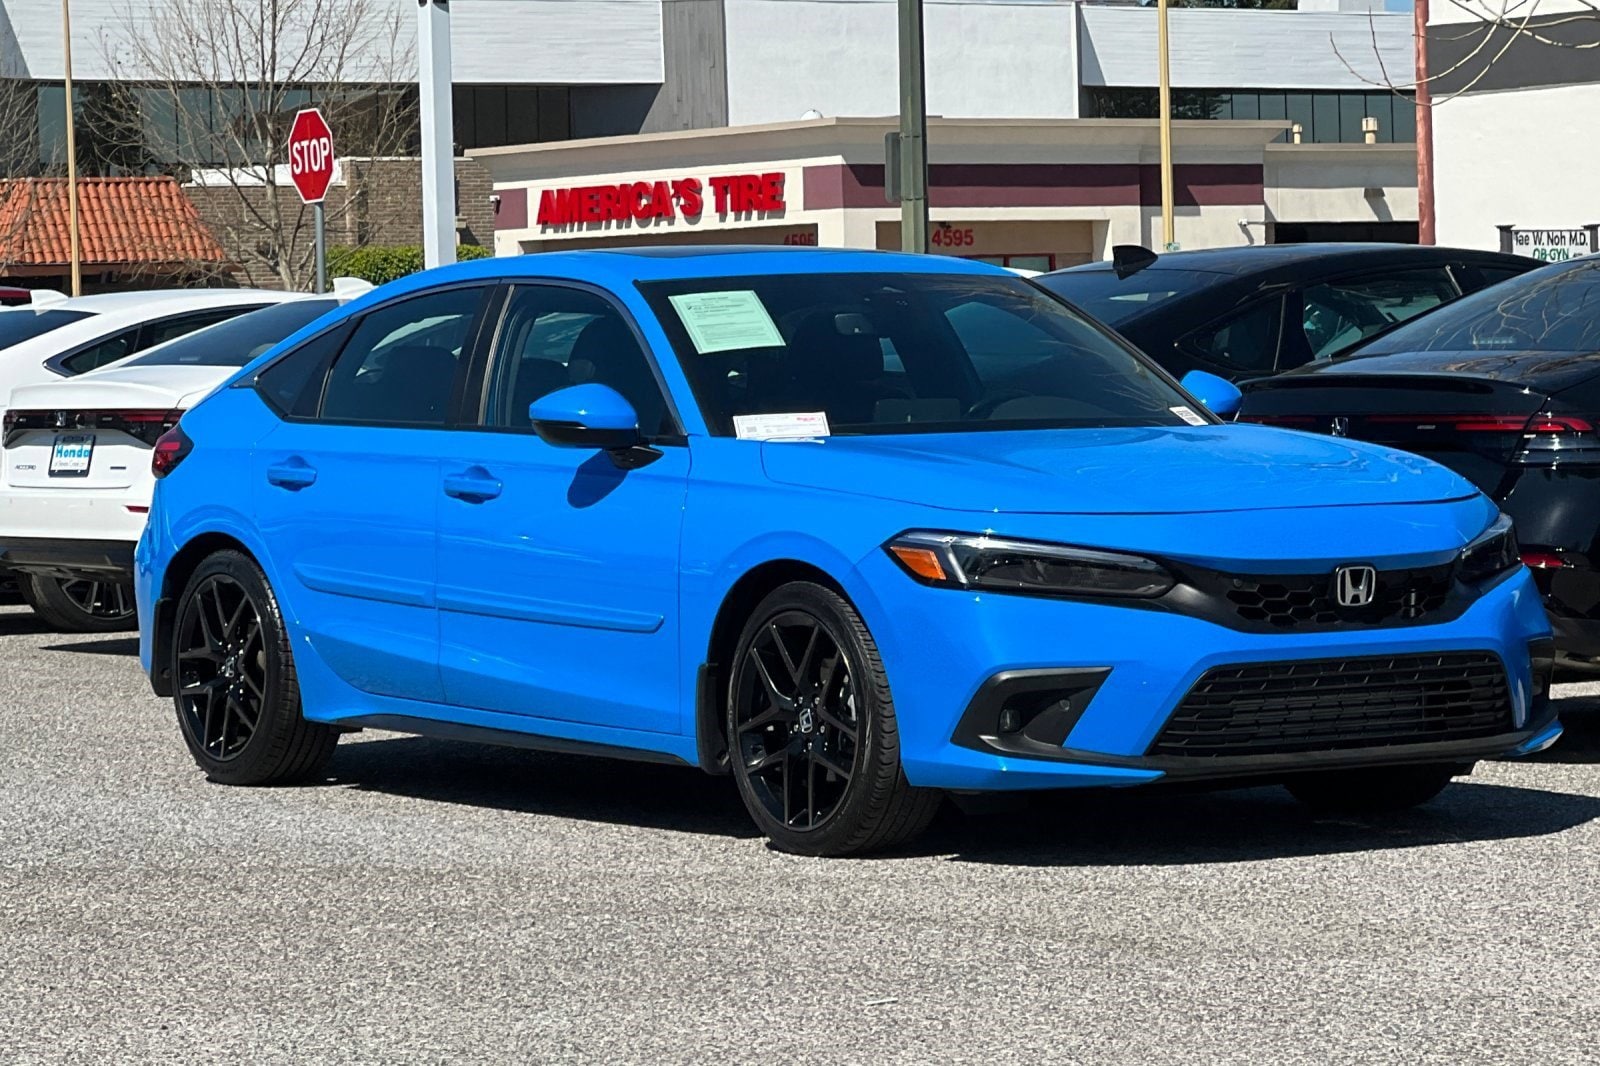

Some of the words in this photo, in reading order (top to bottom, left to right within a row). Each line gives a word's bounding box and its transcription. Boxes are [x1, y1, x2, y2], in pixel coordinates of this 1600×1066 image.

[292, 137, 330, 175] STOP
[536, 178, 703, 225] AMERICA'S
[709, 172, 785, 214] TIRE
[931, 228, 974, 247] 4595
[1514, 231, 1530, 246] Tae
[1547, 231, 1566, 246] Noh
[1533, 247, 1570, 261] OB-GYN
[56, 444, 91, 458] Honda
